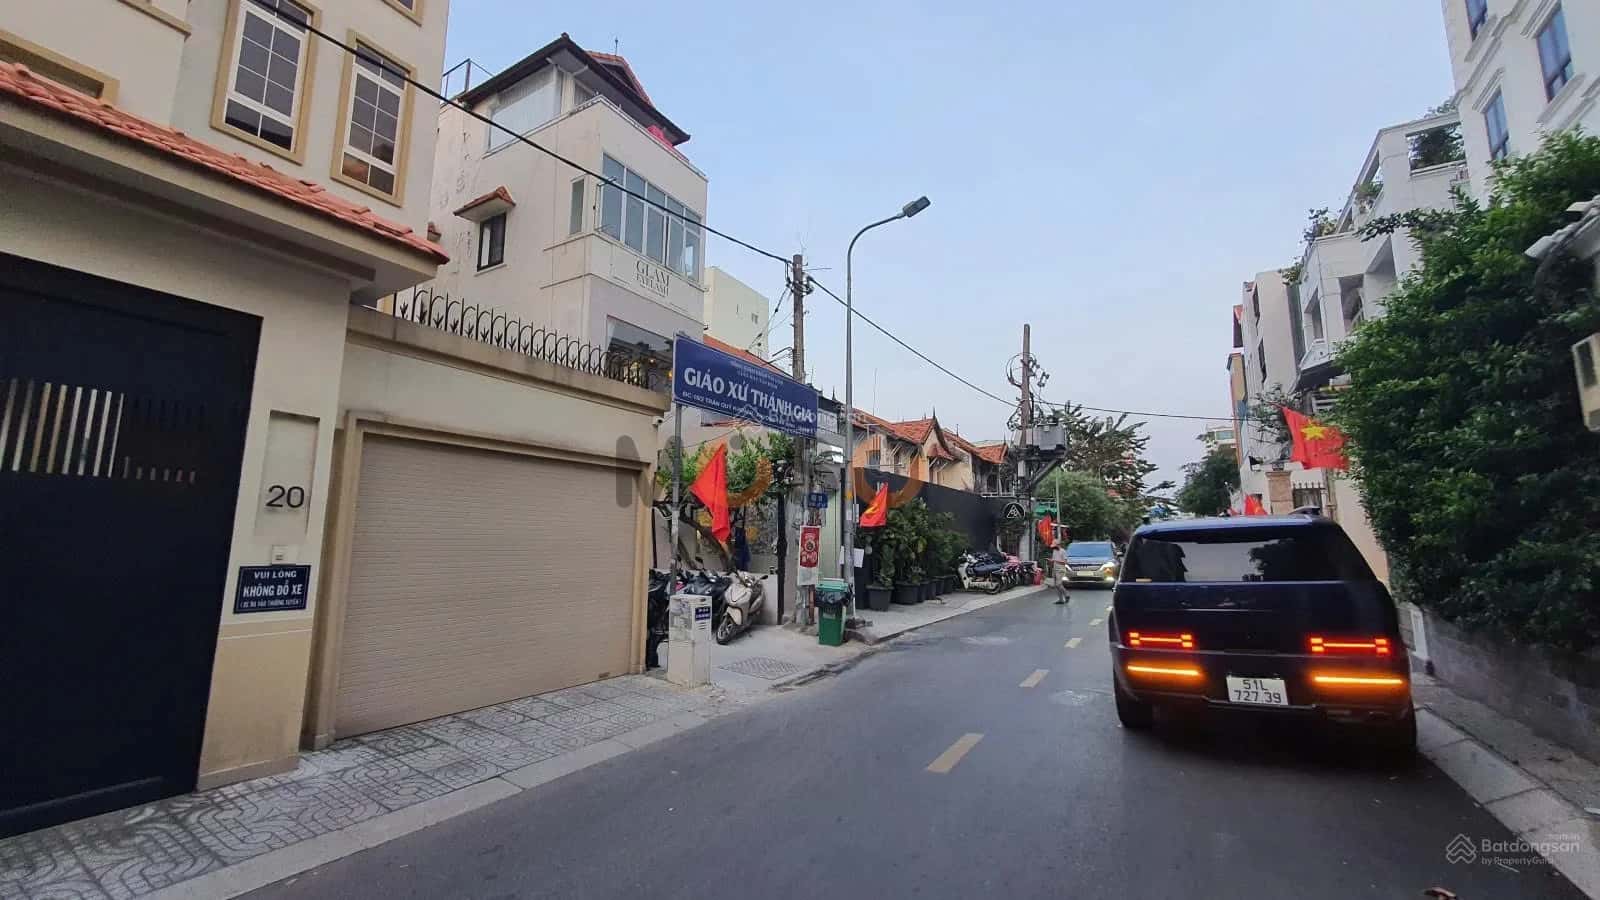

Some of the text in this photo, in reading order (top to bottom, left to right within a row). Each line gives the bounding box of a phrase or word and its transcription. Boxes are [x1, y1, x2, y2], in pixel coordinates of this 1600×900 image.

[636, 261, 670, 287] GLAM
[683, 367, 725, 395] GIÁO
[727, 380, 749, 402] XỨ
[750, 389, 793, 416] THÁNH
[265, 485, 305, 508] 20
[254, 568, 297, 579] VUI LÒNG
[243, 583, 274, 598] KHÔNG
[291, 583, 304, 595] XE
[1242, 679, 1268, 691] 51L
[1234, 690, 1282, 704] 727 39
